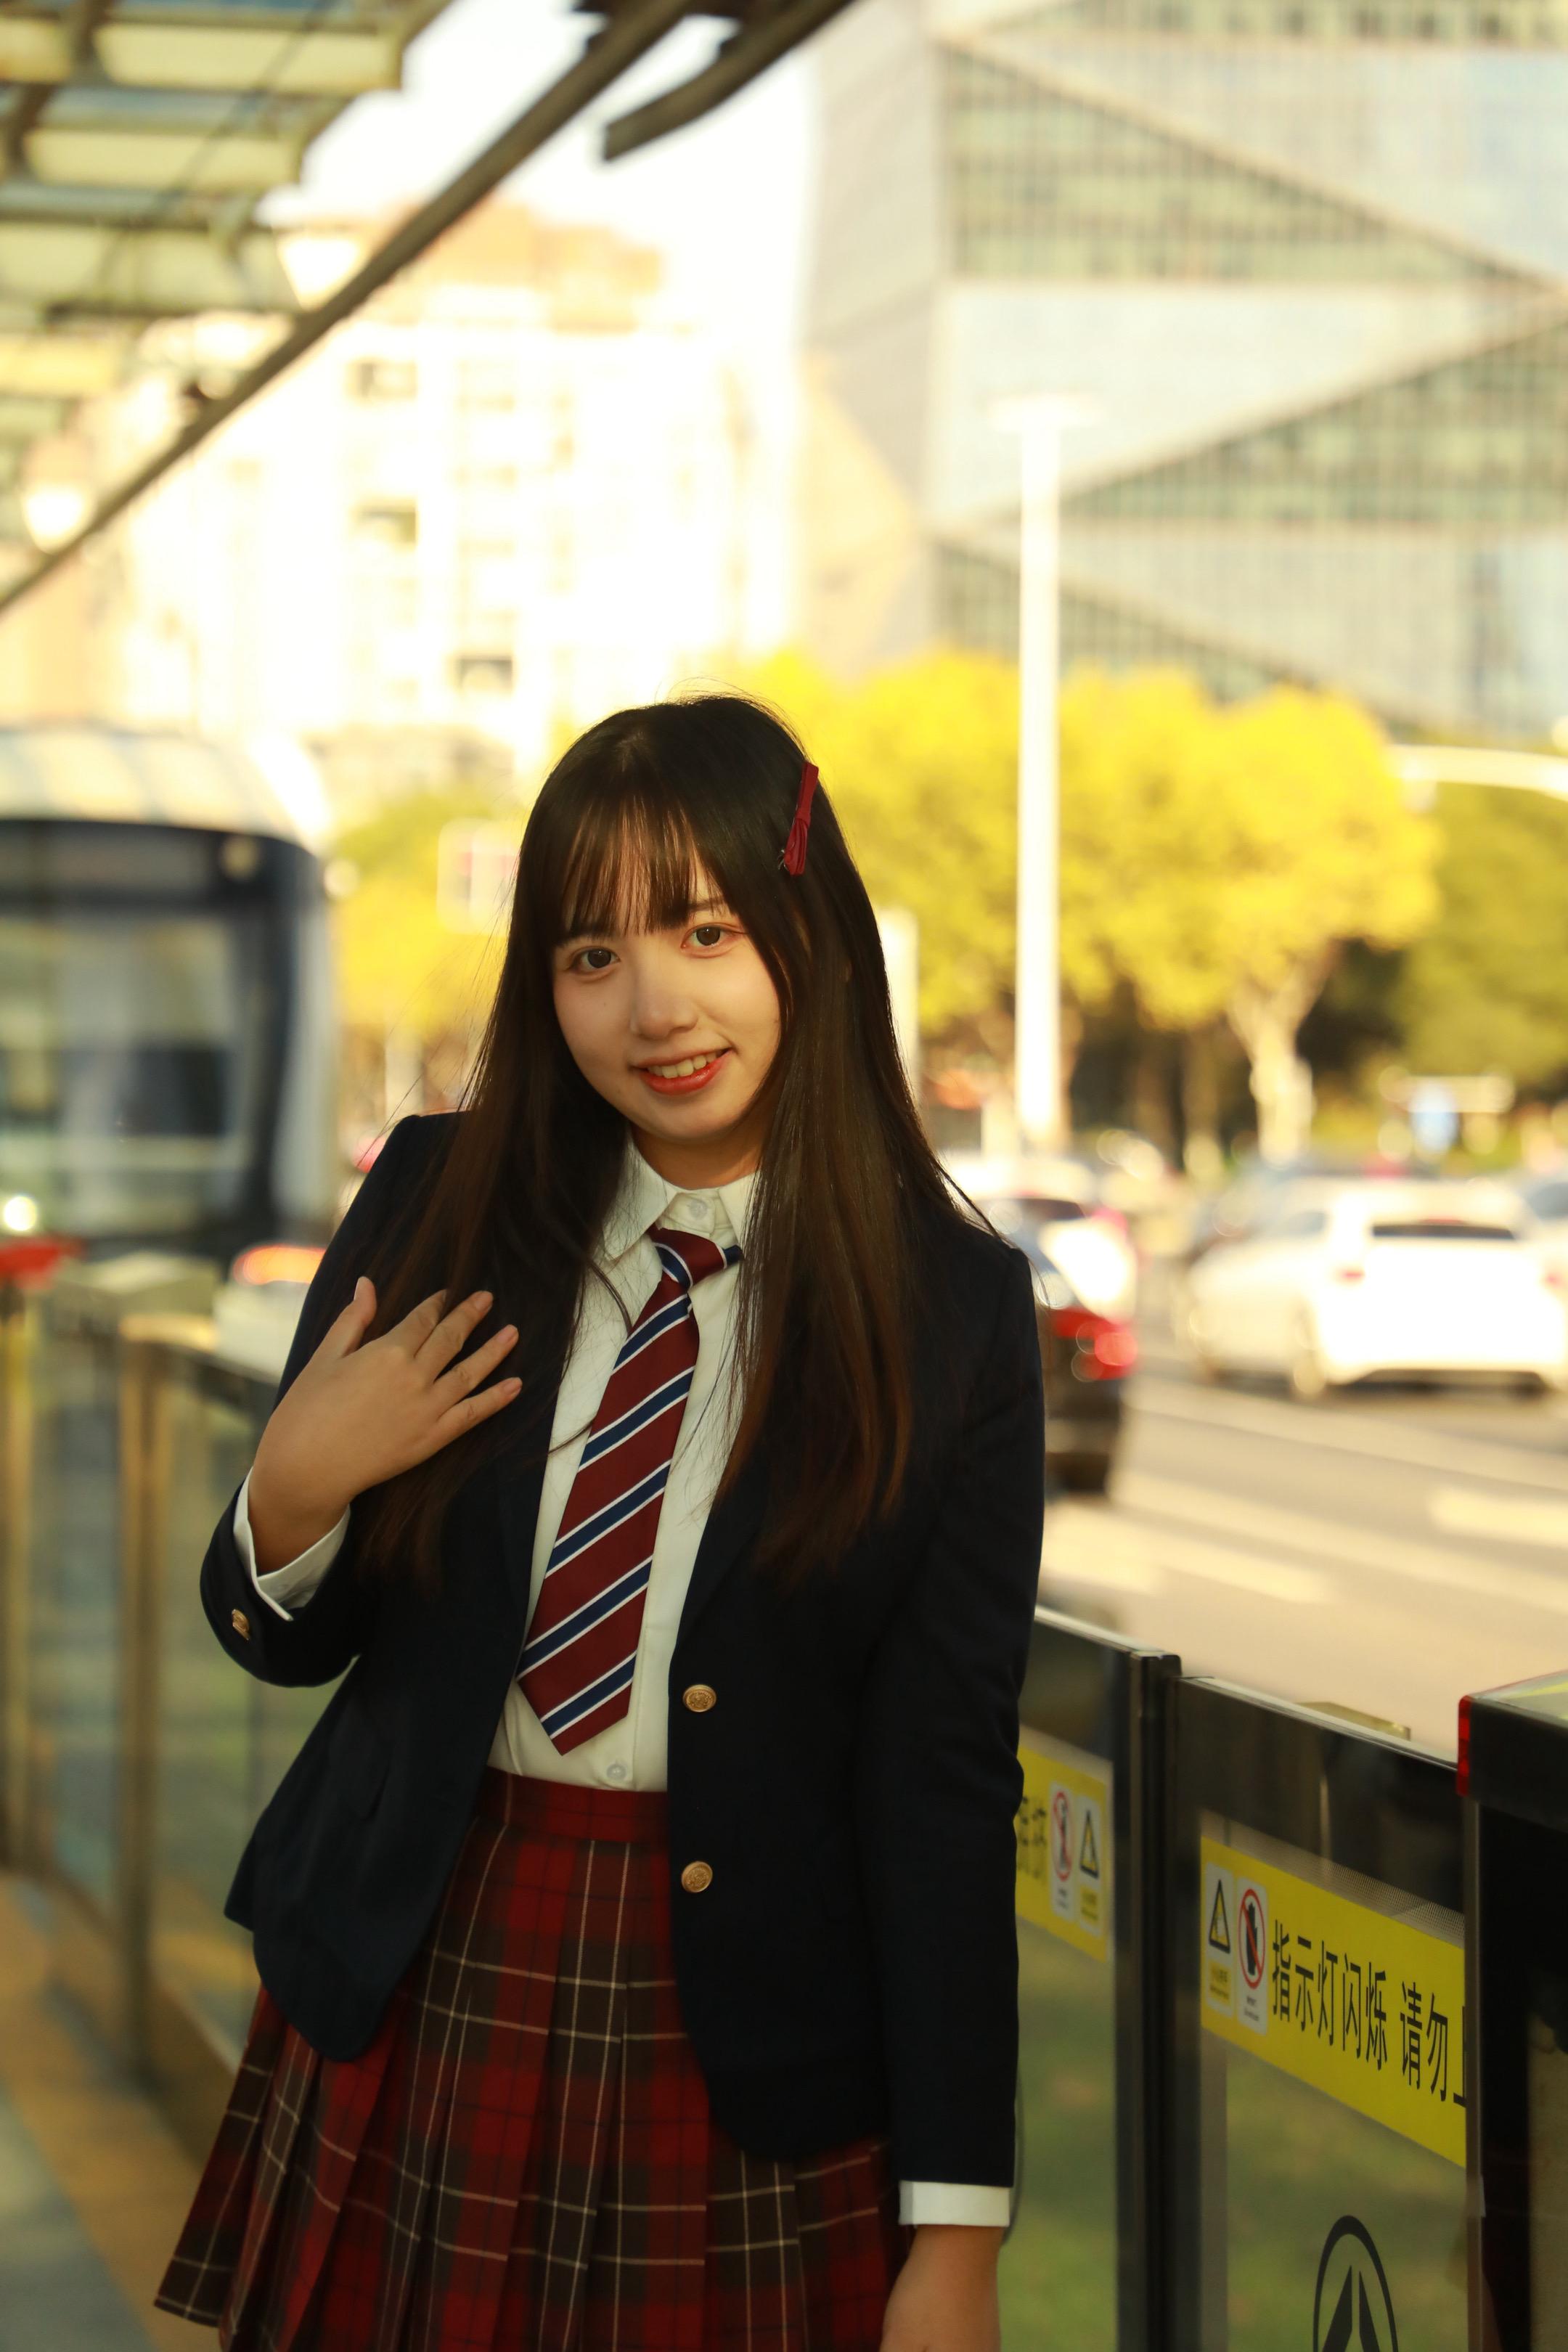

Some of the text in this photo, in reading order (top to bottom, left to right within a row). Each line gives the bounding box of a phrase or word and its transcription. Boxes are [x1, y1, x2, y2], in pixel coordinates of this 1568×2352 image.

[1273, 1919, 1387, 2070] 指示灯闪烁
